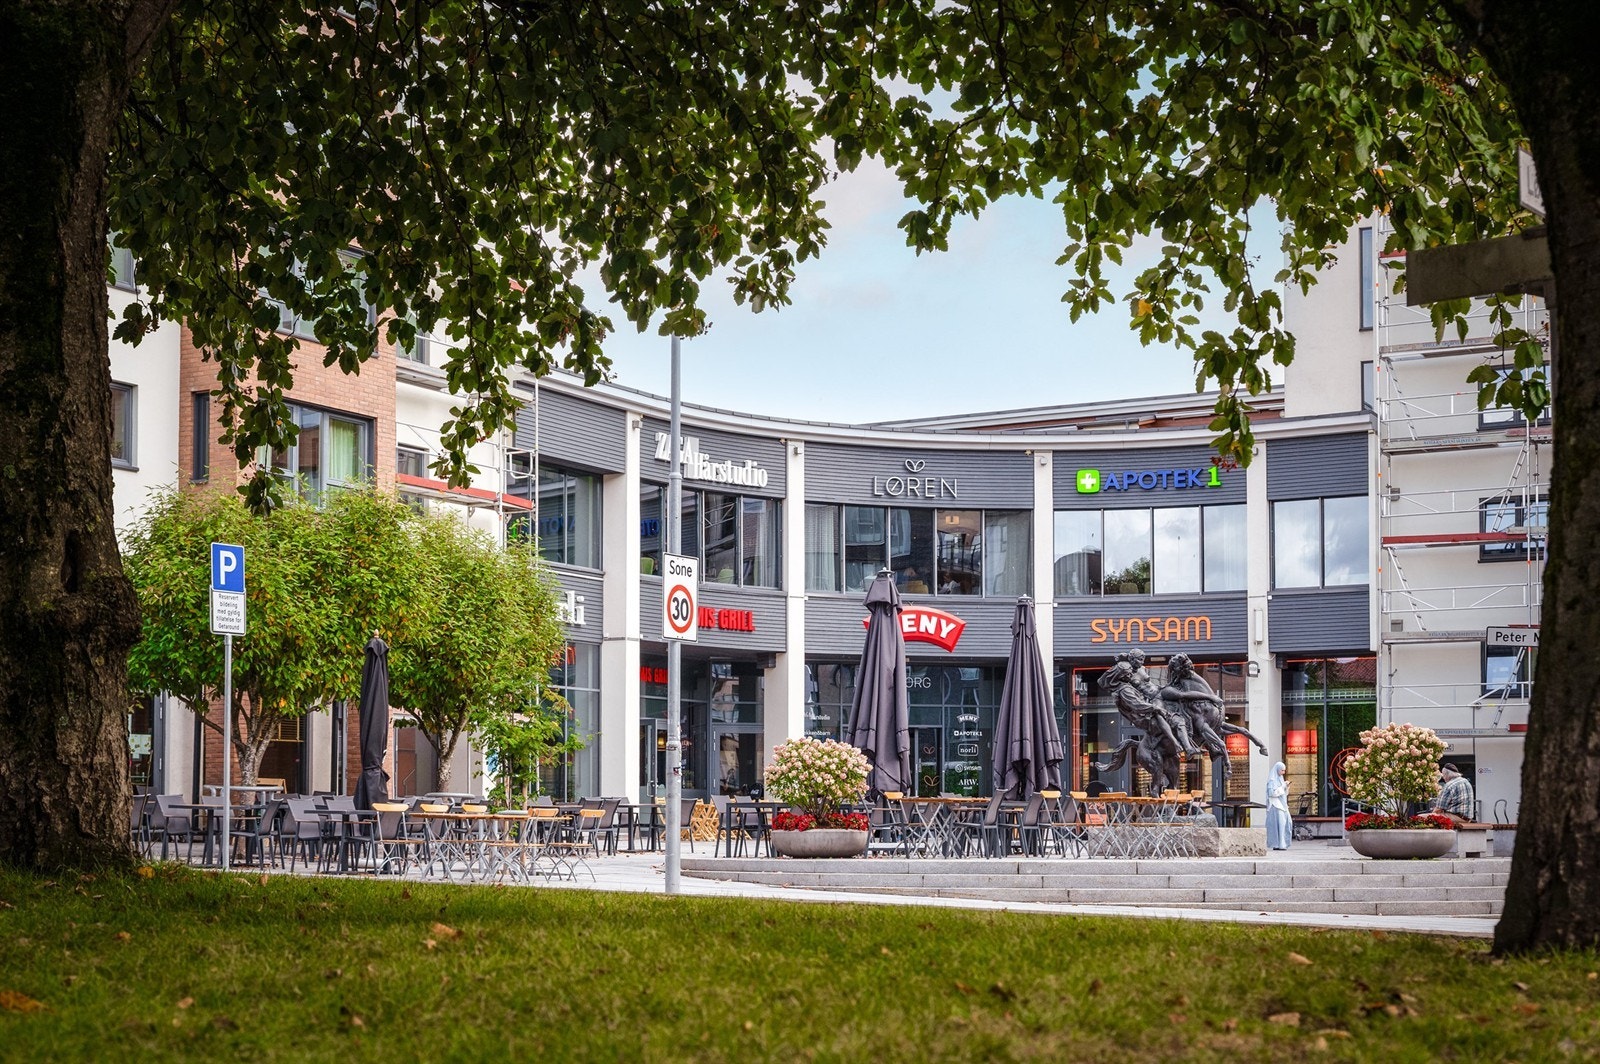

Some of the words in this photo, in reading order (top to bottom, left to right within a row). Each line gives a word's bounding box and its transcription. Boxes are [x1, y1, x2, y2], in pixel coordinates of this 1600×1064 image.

[874, 475, 958, 498] LØREN
[1103, 469, 1205, 491] APOTEK
[1207, 466, 1222, 487] 1
[220, 550, 237, 585] P
[669, 560, 692, 577] Sone
[672, 596, 689, 621] 30
[718, 608, 755, 631] GRILL
[902, 614, 957, 639] ENY
[1090, 616, 1212, 643] SYNSAM
[1495, 631, 1527, 642] Peter
[906, 676, 931, 688] ORG
[960, 745, 977, 753] norli
